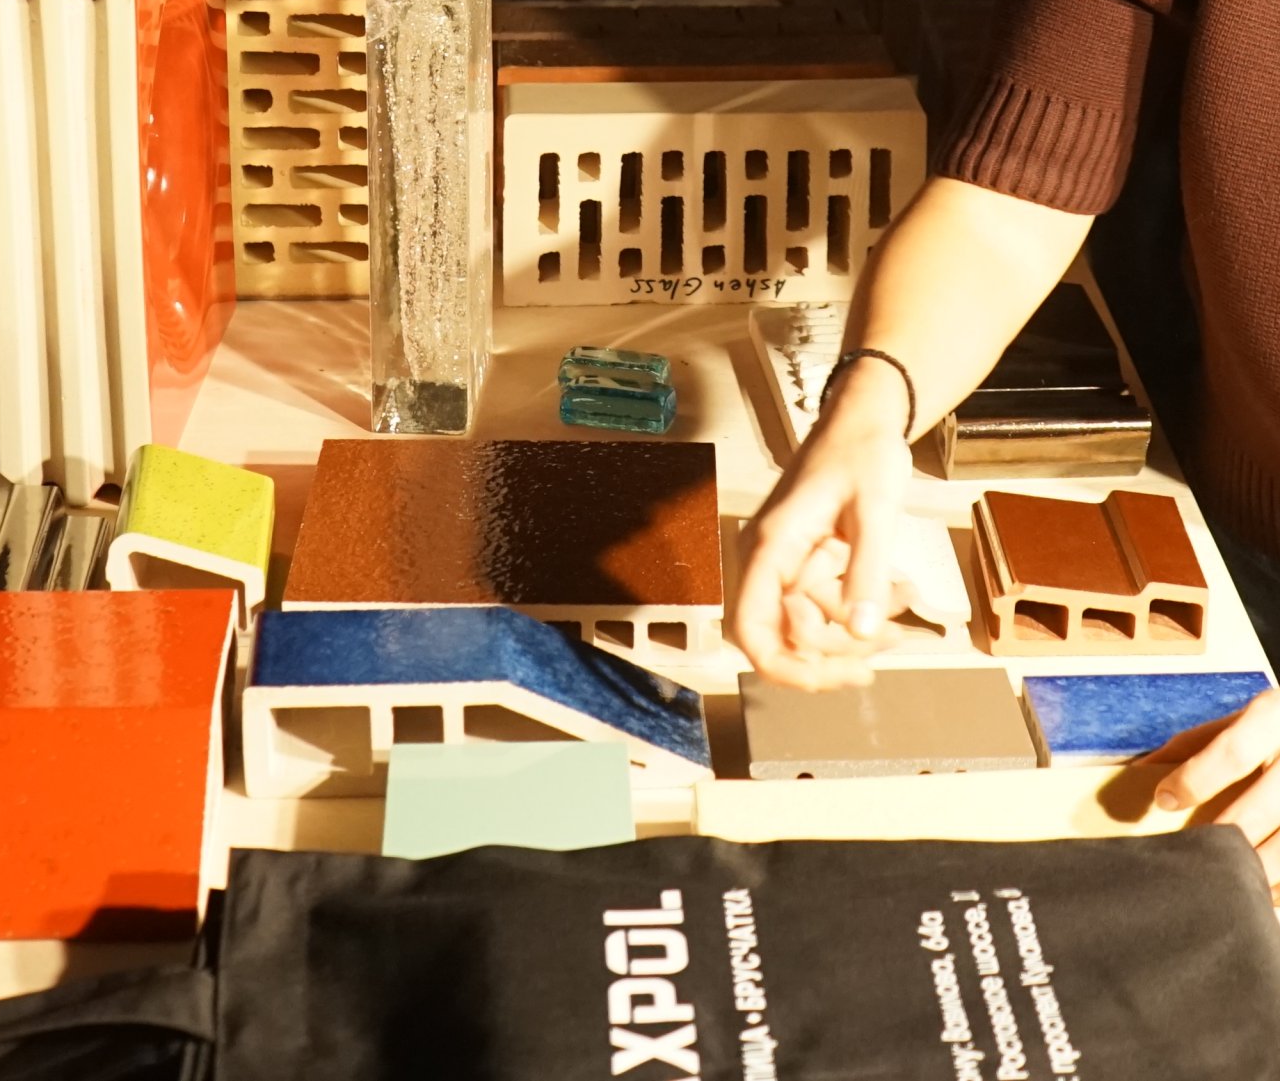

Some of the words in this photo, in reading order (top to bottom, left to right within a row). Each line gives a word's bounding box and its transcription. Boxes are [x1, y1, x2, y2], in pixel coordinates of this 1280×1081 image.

[630, 276, 703, 301] Glass
[713, 277, 787, 299] Ashen
[722, 888, 768, 1012] БРУСЧАТКА
[917, 910, 950, 952] 64а
[964, 902, 1001, 976] шоссе,
[1007, 896, 1055, 987] Кулакова,
[602, 888, 702, 1081] XPOL
[931, 953, 973, 1043] Вавилова,
[980, 975, 1030, 1081] Ростовское
[1030, 985, 1082, 1074] проспект
